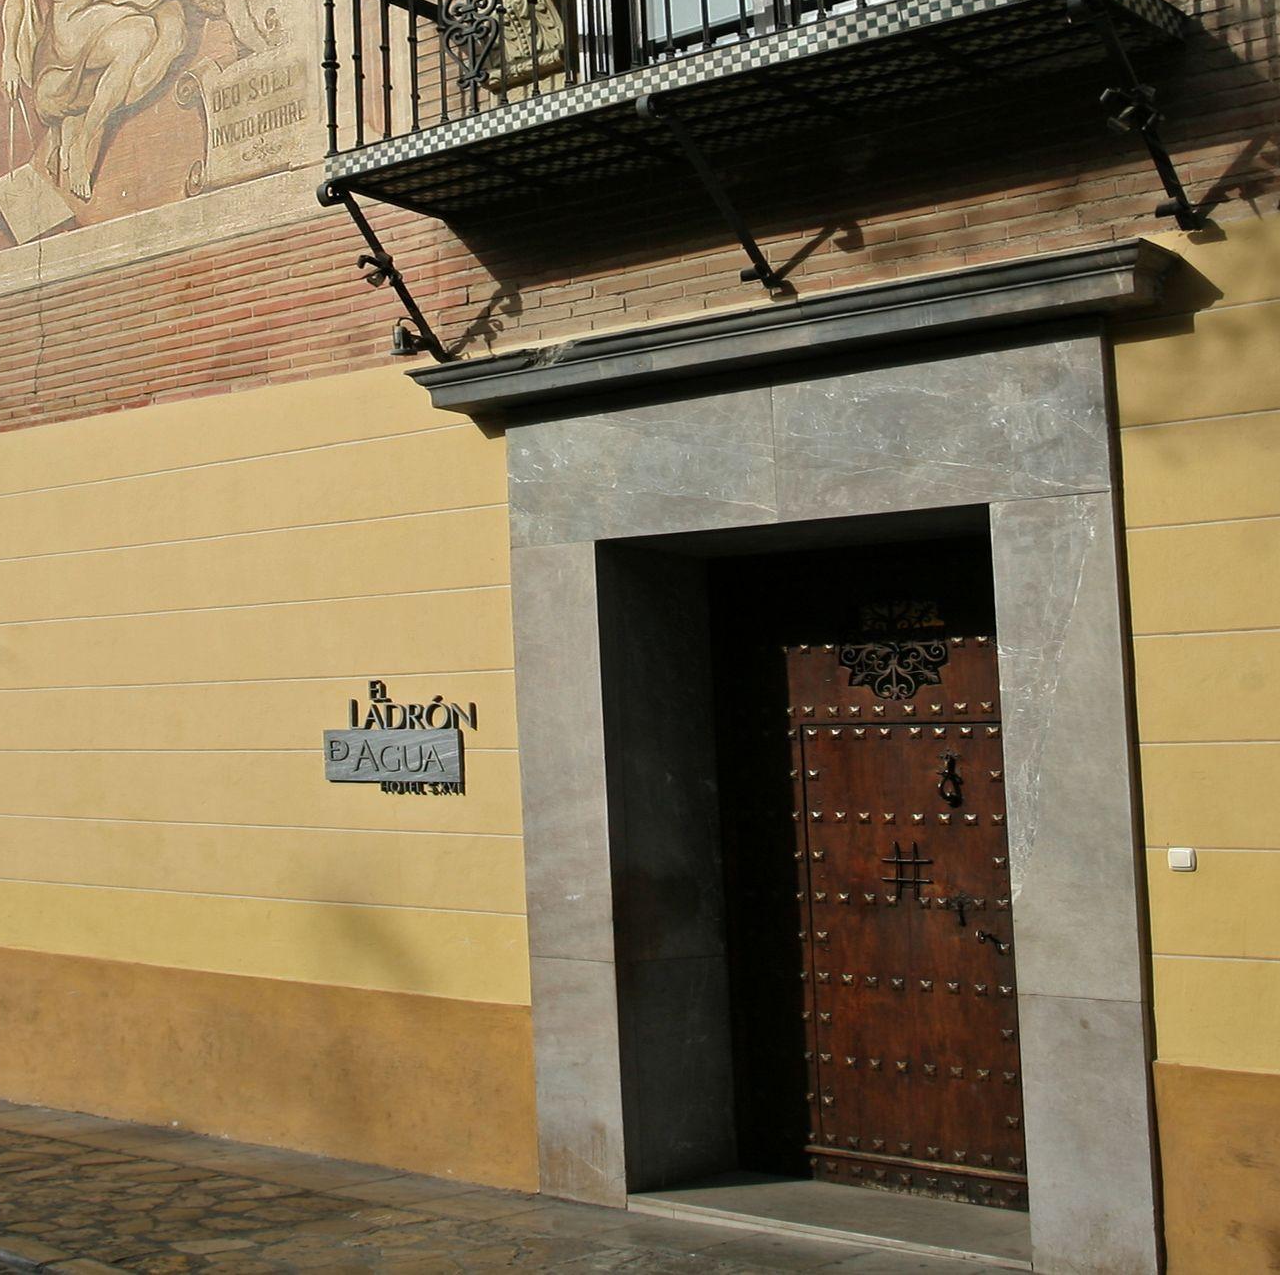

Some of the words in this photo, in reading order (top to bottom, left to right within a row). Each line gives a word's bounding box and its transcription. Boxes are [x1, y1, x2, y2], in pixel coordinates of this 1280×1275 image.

[213, 83, 240, 114] DEO
[211, 116, 255, 149] INVICTO
[349, 694, 477, 731] LADRÓN
[353, 738, 446, 773] AGUA
